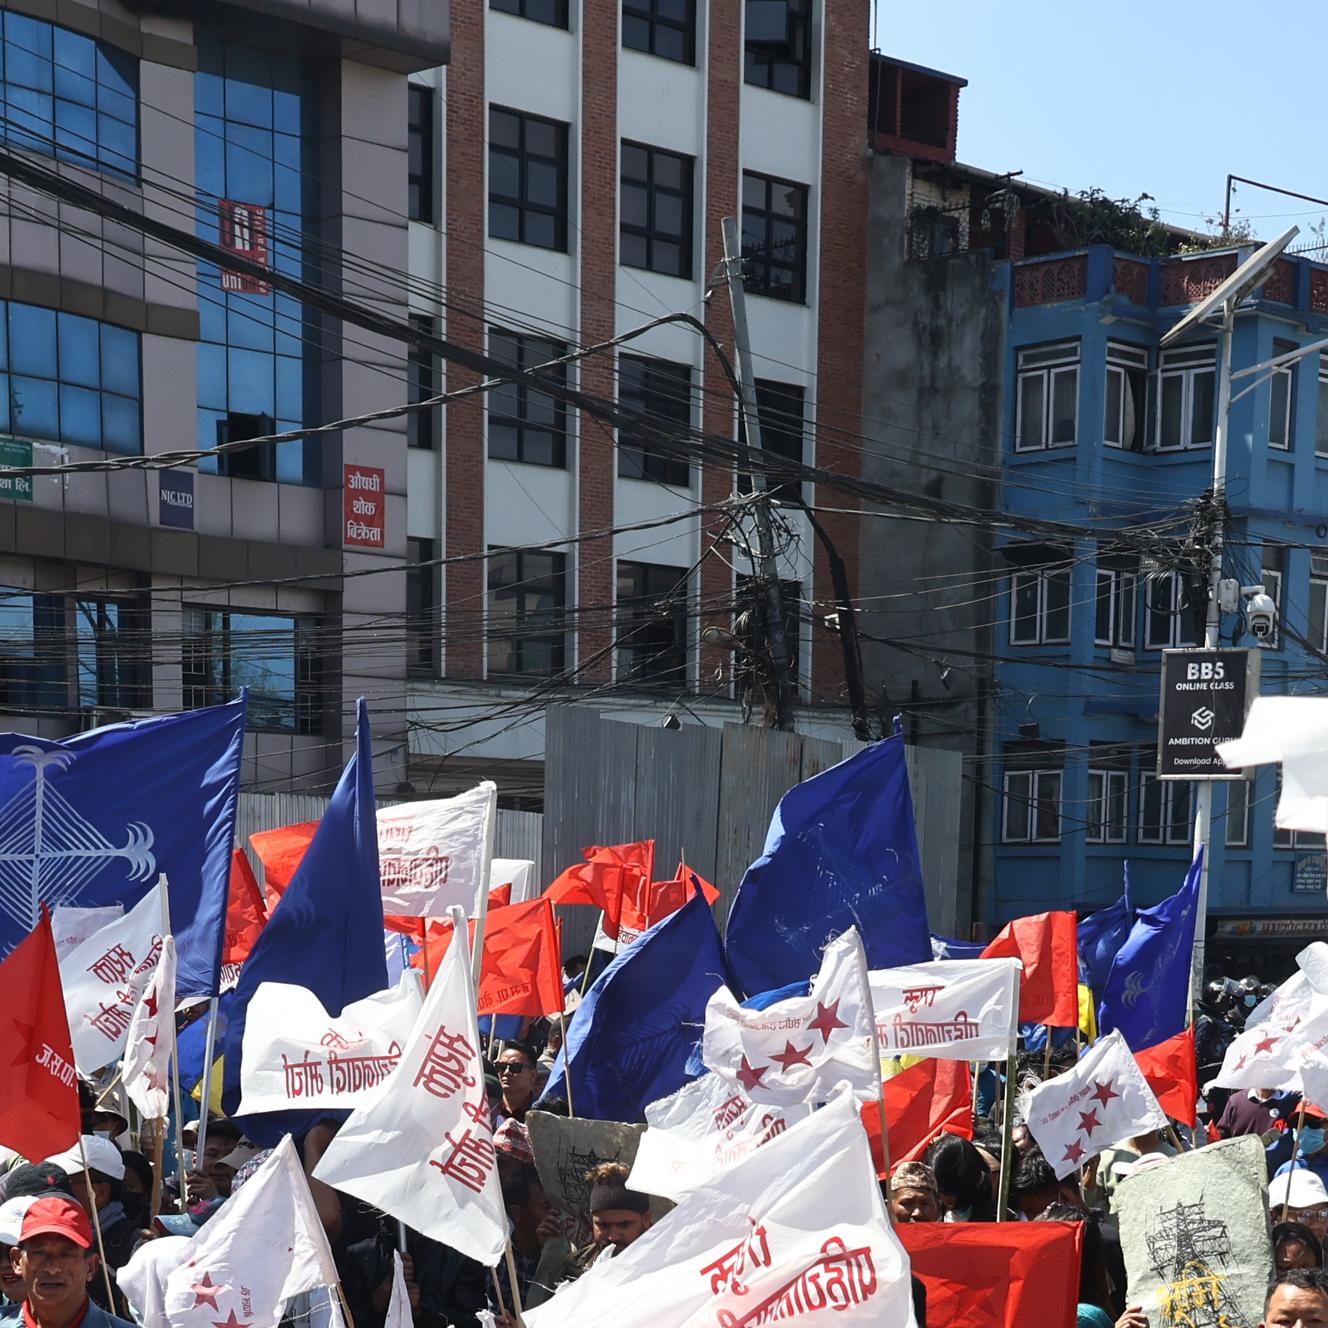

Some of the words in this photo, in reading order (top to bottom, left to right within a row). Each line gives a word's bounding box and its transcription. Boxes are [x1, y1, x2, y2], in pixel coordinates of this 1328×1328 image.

[348, 471, 380, 492] औषधी
[160, 489, 176, 505] NJC
[177, 491, 193, 506] LTD
[352, 497, 376, 516] थोक
[347, 521, 381, 543] बिक्रेता
[1187, 662, 1225, 680] BBS
[1175, 683, 1208, 691] ONLINE
[1209, 682, 1235, 690] CLASS
[1168, 737, 1211, 746] AMBITION
[1173, 757, 1211, 766] Download
